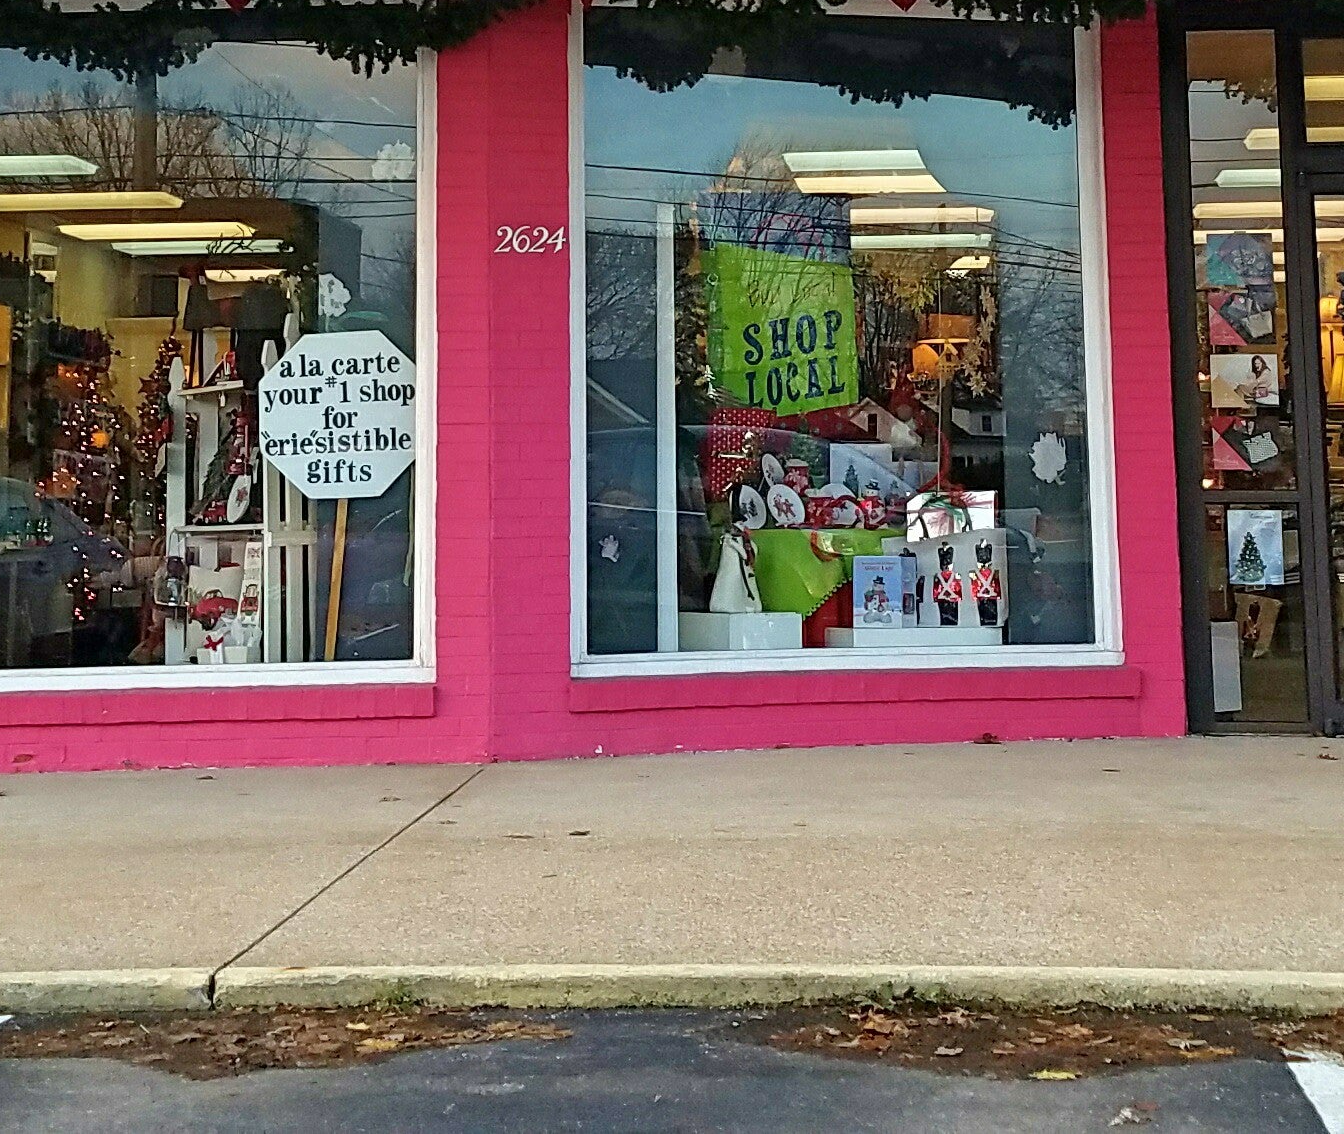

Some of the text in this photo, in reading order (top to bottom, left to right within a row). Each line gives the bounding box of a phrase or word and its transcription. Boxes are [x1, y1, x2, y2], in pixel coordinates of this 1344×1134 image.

[494, 225, 567, 254] 2624
[742, 309, 843, 366] SHOP
[279, 351, 401, 378] a la carte
[263, 375, 415, 413] your #1 shop
[744, 355, 846, 408] LOCAL
[321, 405, 358, 430] for
[306, 458, 372, 484] gifts
